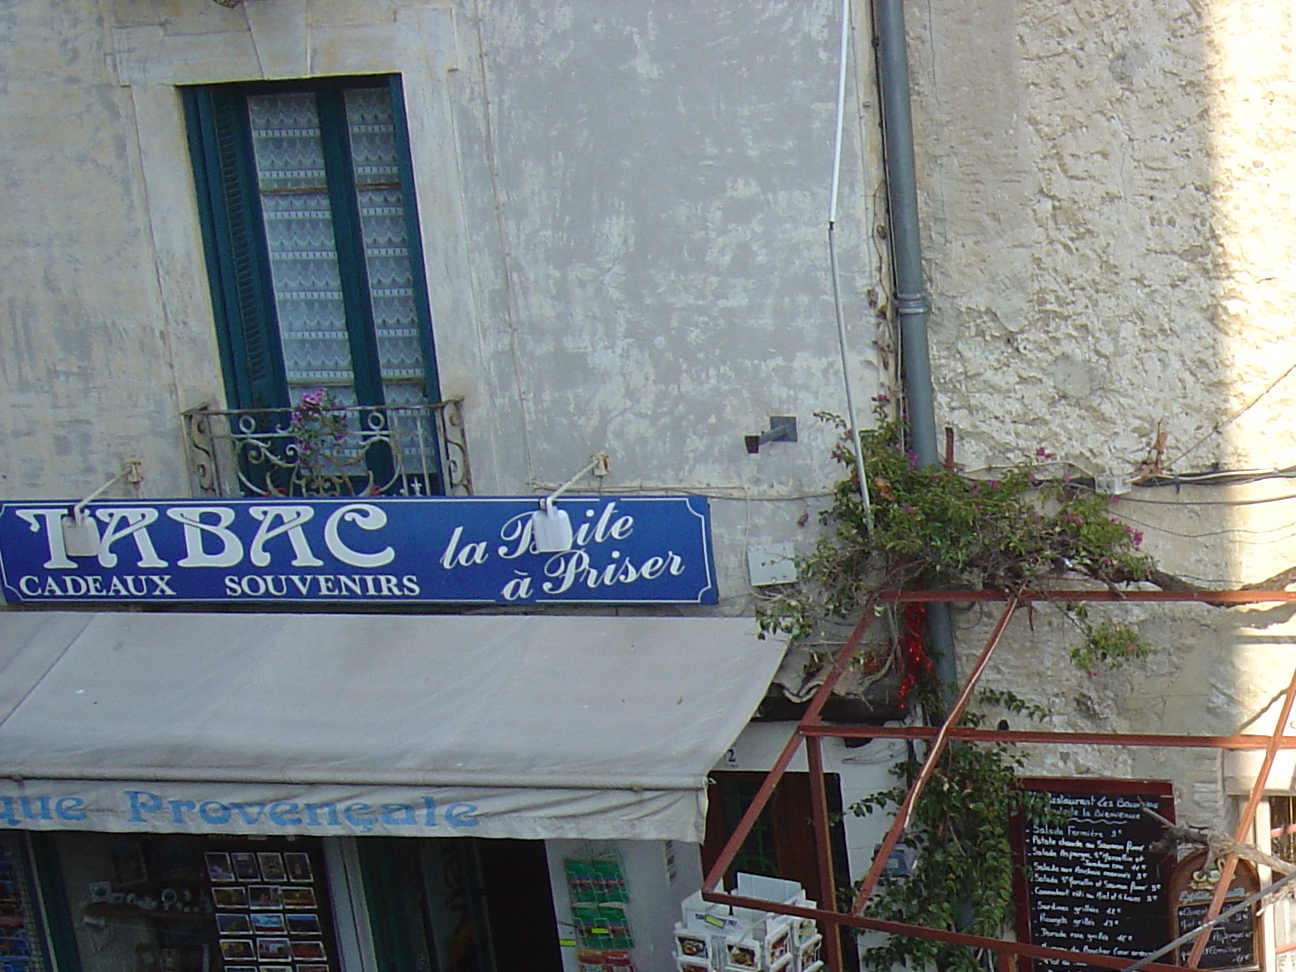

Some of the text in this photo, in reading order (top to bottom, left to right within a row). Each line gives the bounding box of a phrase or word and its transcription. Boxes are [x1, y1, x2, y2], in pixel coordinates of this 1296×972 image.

[15, 504, 395, 568] TABAC
[440, 526, 489, 570] la
[19, 575, 421, 596] CADEAUX SOUVENIRS
[501, 548, 686, 600] à Priser
[123, 790, 480, 832] Provençale
